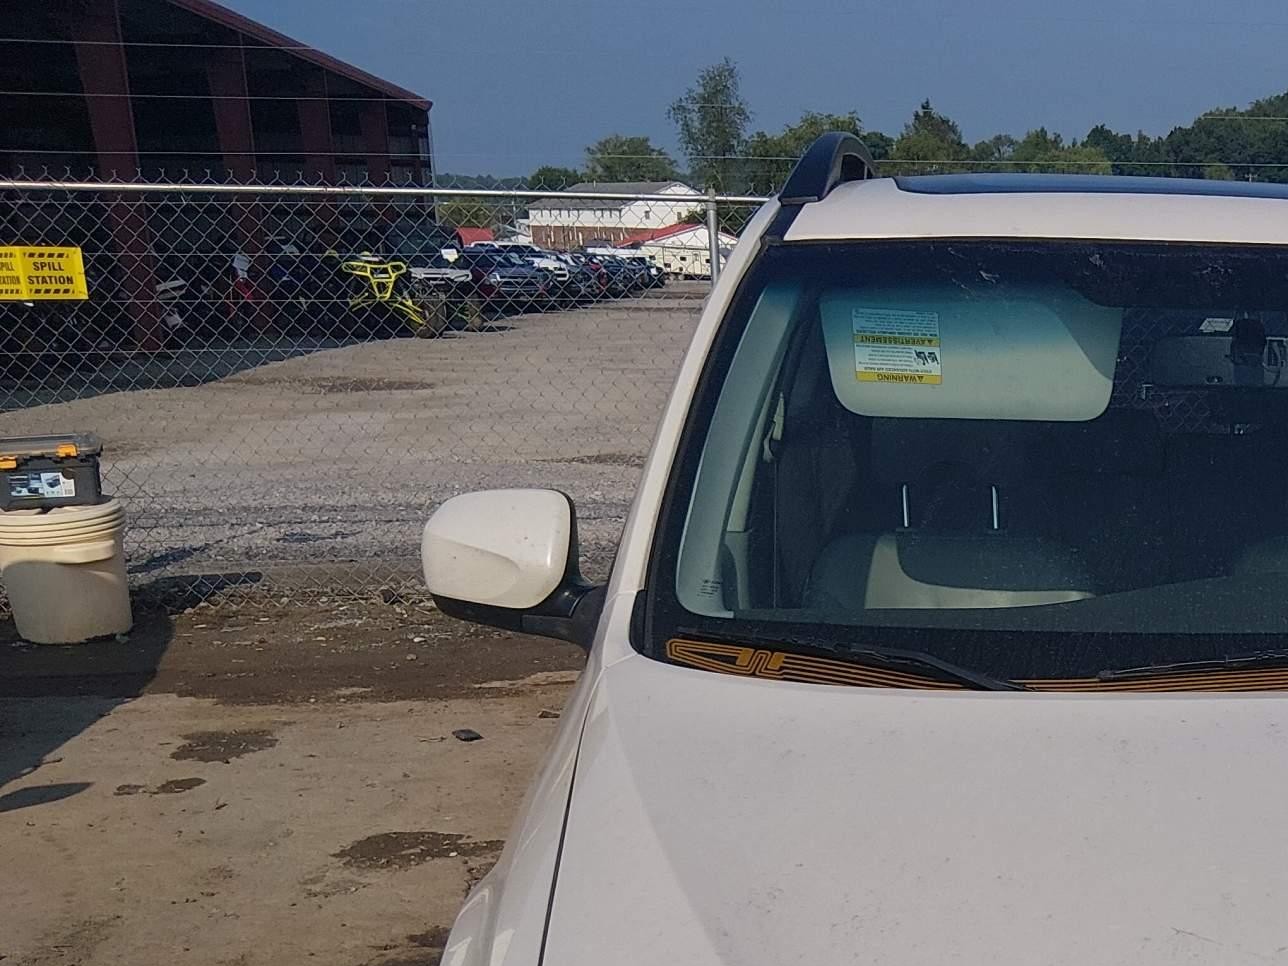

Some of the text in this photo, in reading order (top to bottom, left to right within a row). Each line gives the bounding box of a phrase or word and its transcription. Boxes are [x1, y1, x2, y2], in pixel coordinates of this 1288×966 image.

[33, 262, 64, 271] SPILL
[27, 275, 74, 285] STATION
[877, 374, 917, 382] WARNING
